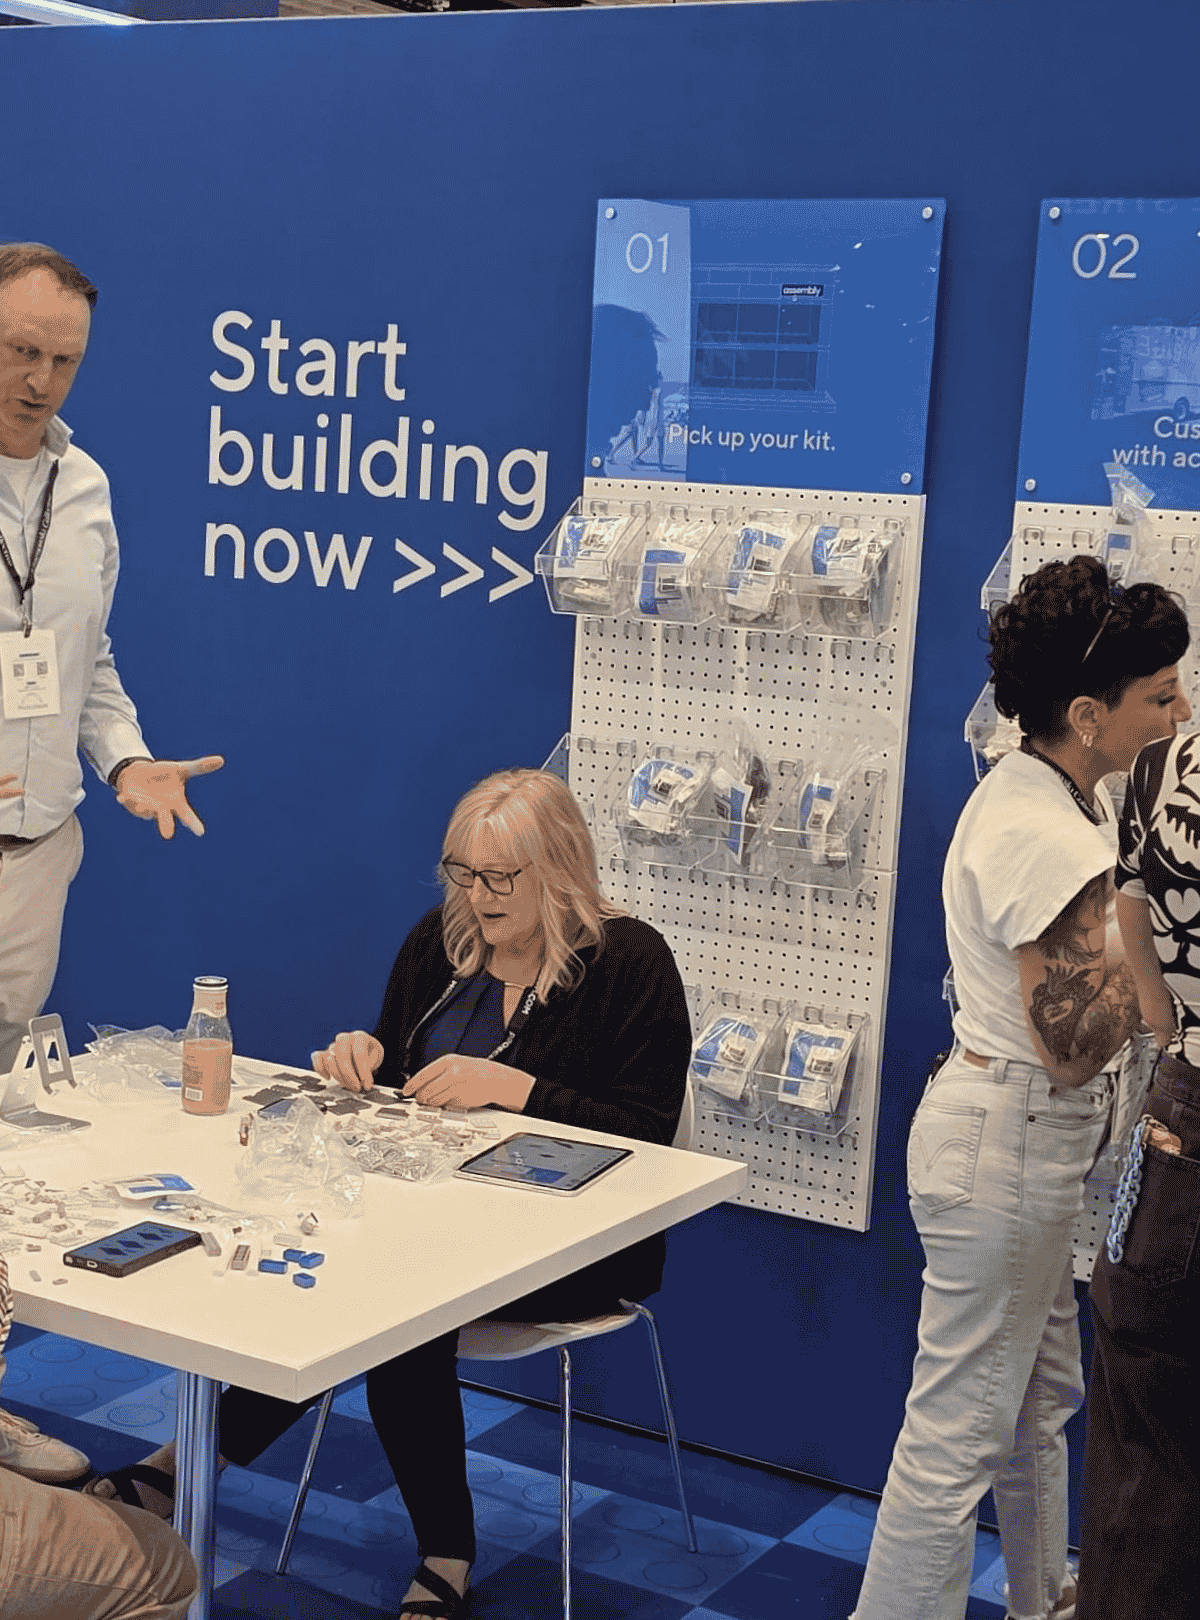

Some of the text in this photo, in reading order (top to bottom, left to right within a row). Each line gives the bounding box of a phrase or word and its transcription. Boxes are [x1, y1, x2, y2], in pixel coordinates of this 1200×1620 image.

[626, 233, 669, 273] 01
[1072, 233, 1140, 279] 02
[209, 310, 406, 401] Start
[668, 424, 836, 452] Pick up your kit.
[1113, 444, 1166, 468] with
[208, 405, 548, 531] building
[204, 522, 373, 591] now
